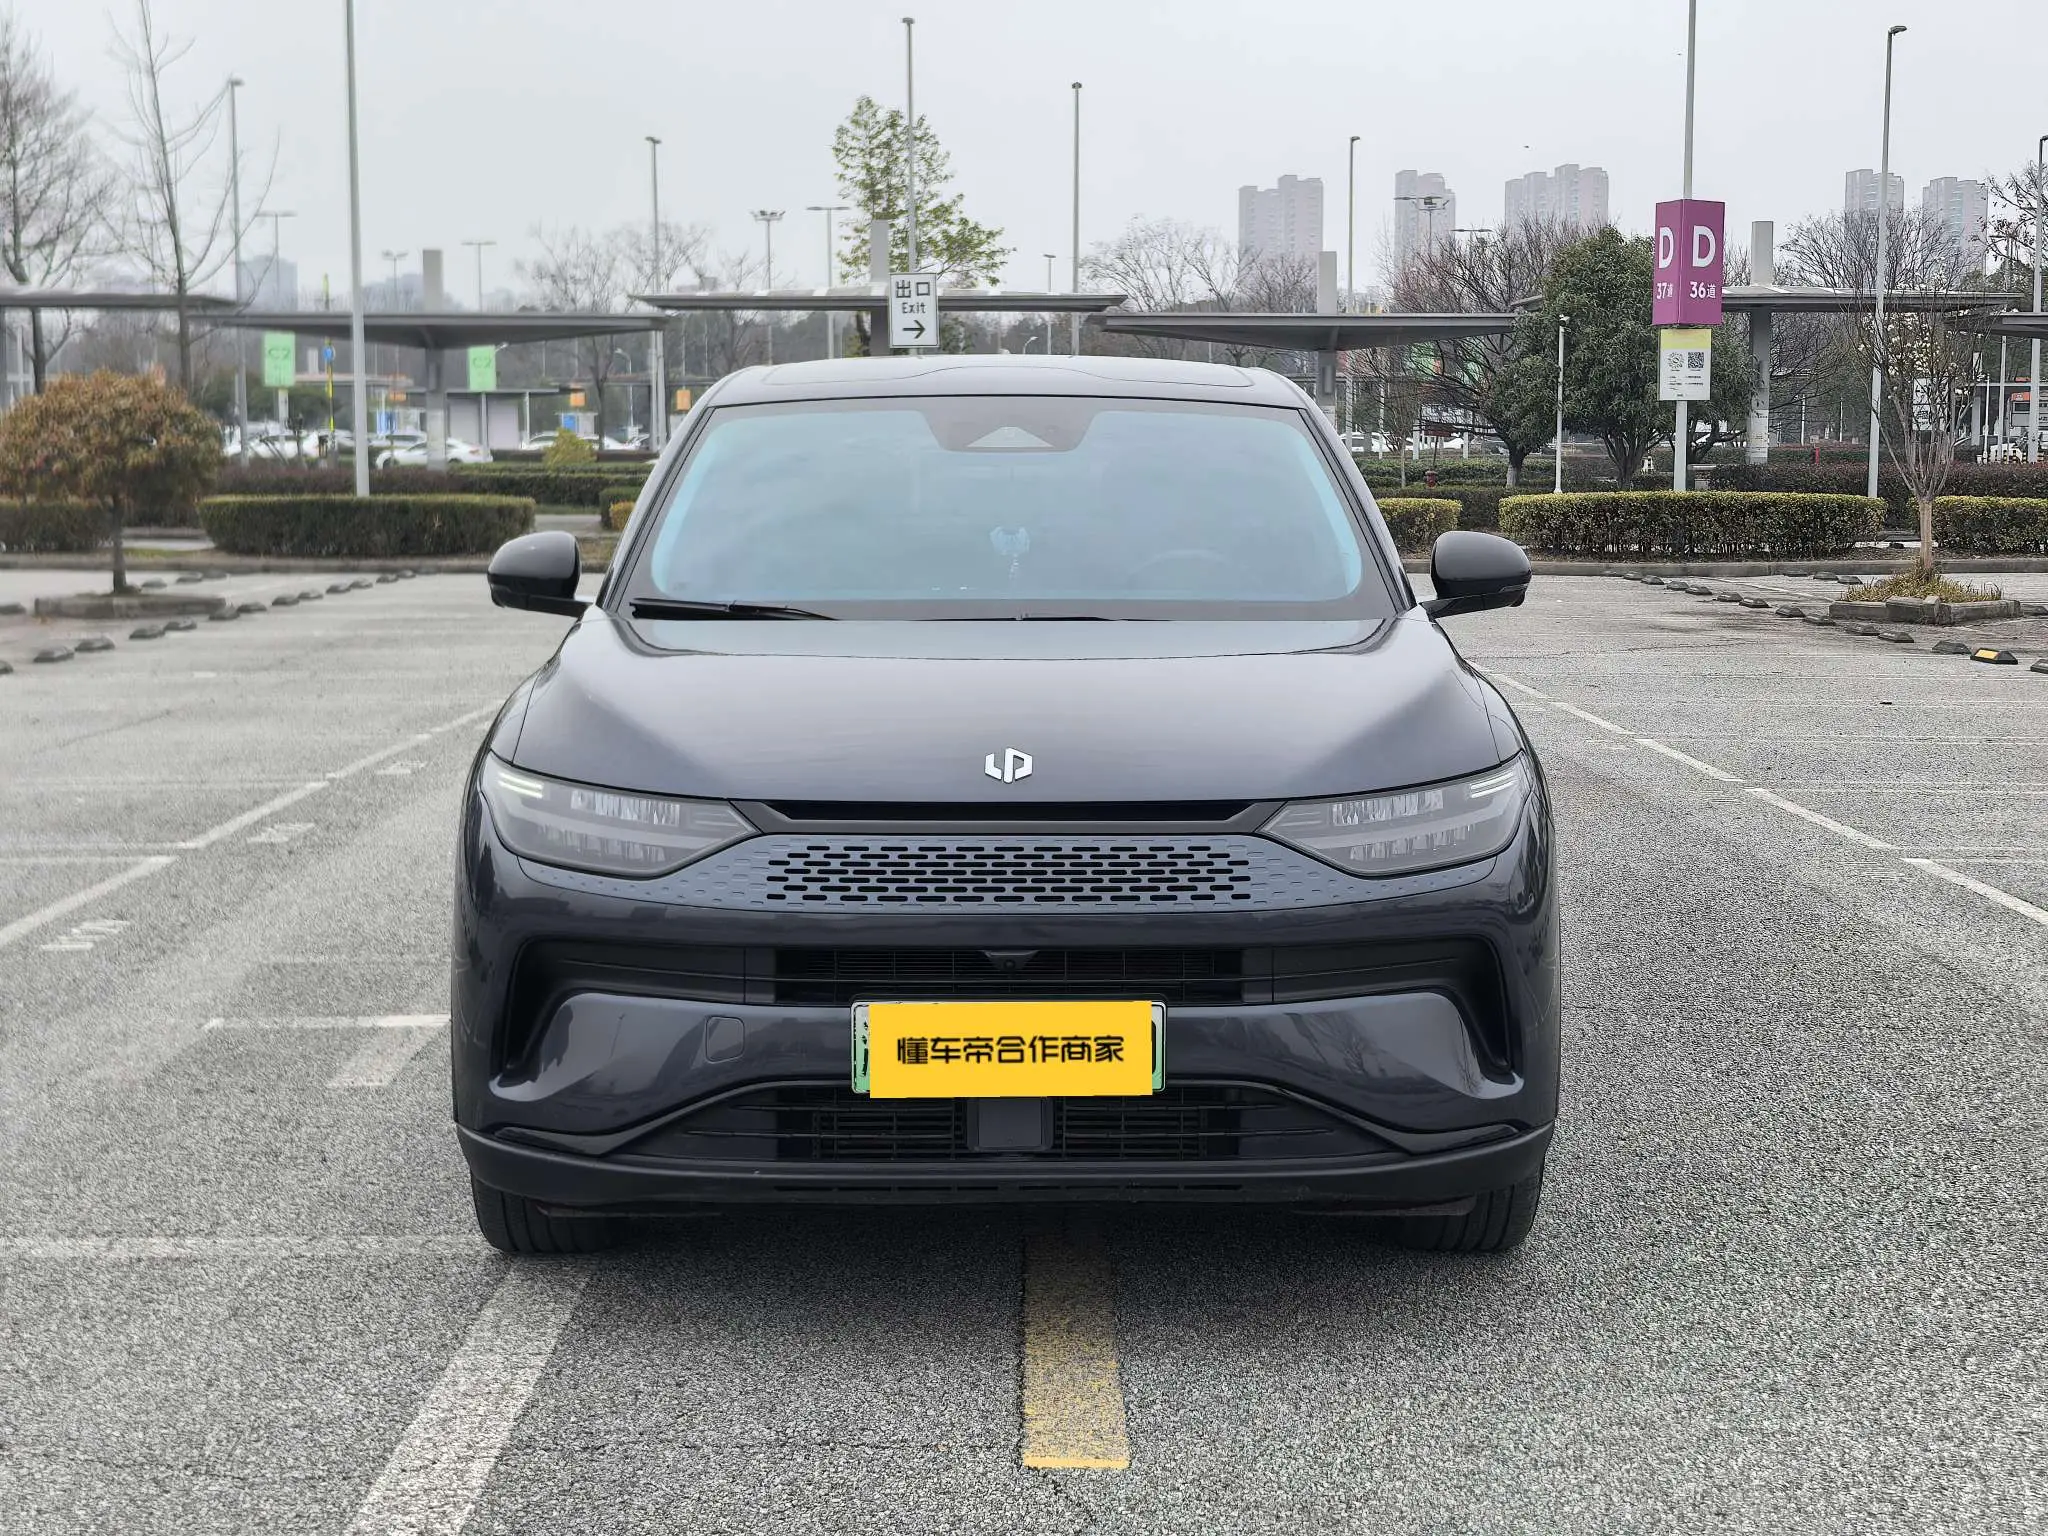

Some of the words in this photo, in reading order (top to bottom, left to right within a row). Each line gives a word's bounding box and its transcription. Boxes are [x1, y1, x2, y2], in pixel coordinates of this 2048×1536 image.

[1658, 226, 1674, 269] D
[1692, 225, 1716, 267] D
[896, 280, 930, 298] 出口
[1656, 282, 1673, 299] 37道
[1689, 281, 1716, 298] 36道
[902, 302, 926, 314] Exit
